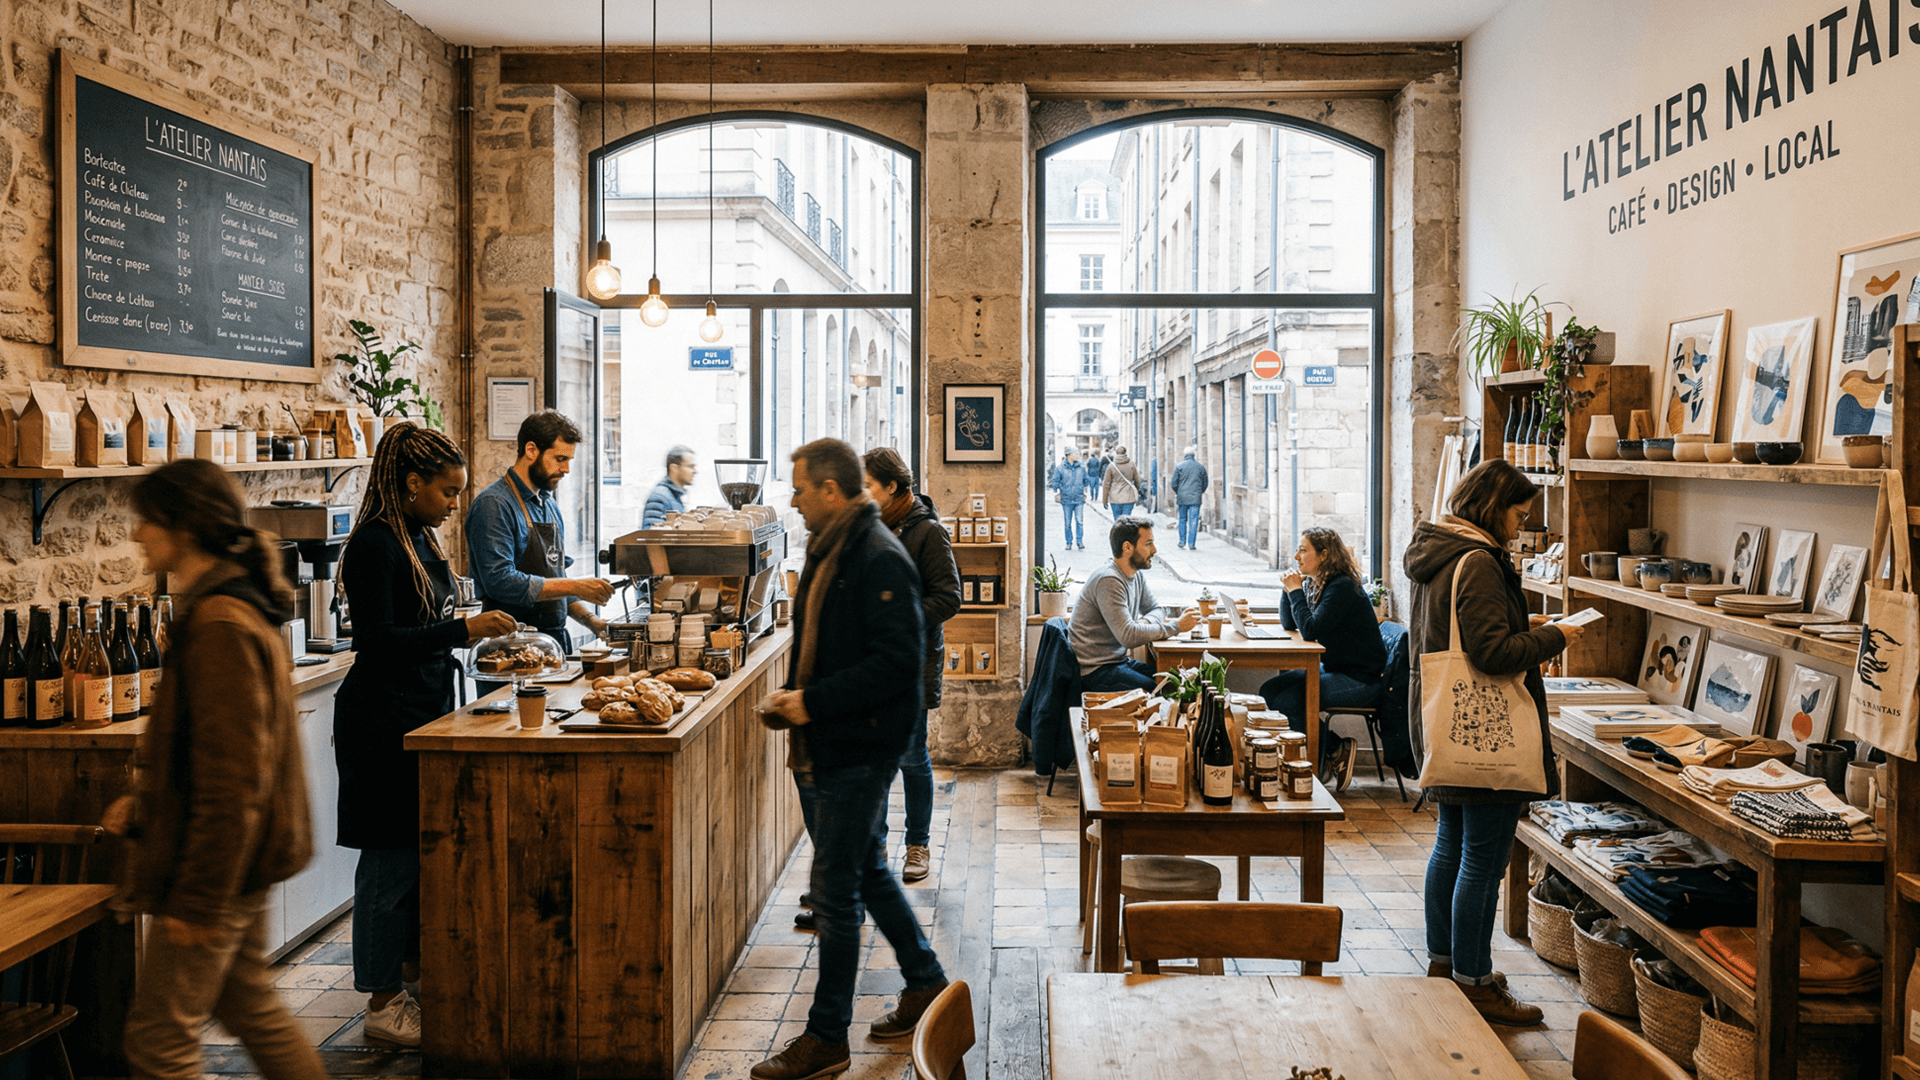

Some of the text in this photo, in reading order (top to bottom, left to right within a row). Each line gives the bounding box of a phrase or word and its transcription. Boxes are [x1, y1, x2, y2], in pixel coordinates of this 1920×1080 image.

[84, 170, 106, 189] Café
[109, 177, 118, 193] de
[145, 116, 267, 182] L'ATELIER NANTAIS
[1563, 82, 1708, 201] L'ATELIER
[1608, 120, 1840, 235] CAFÉ DESIGN LOCAL
